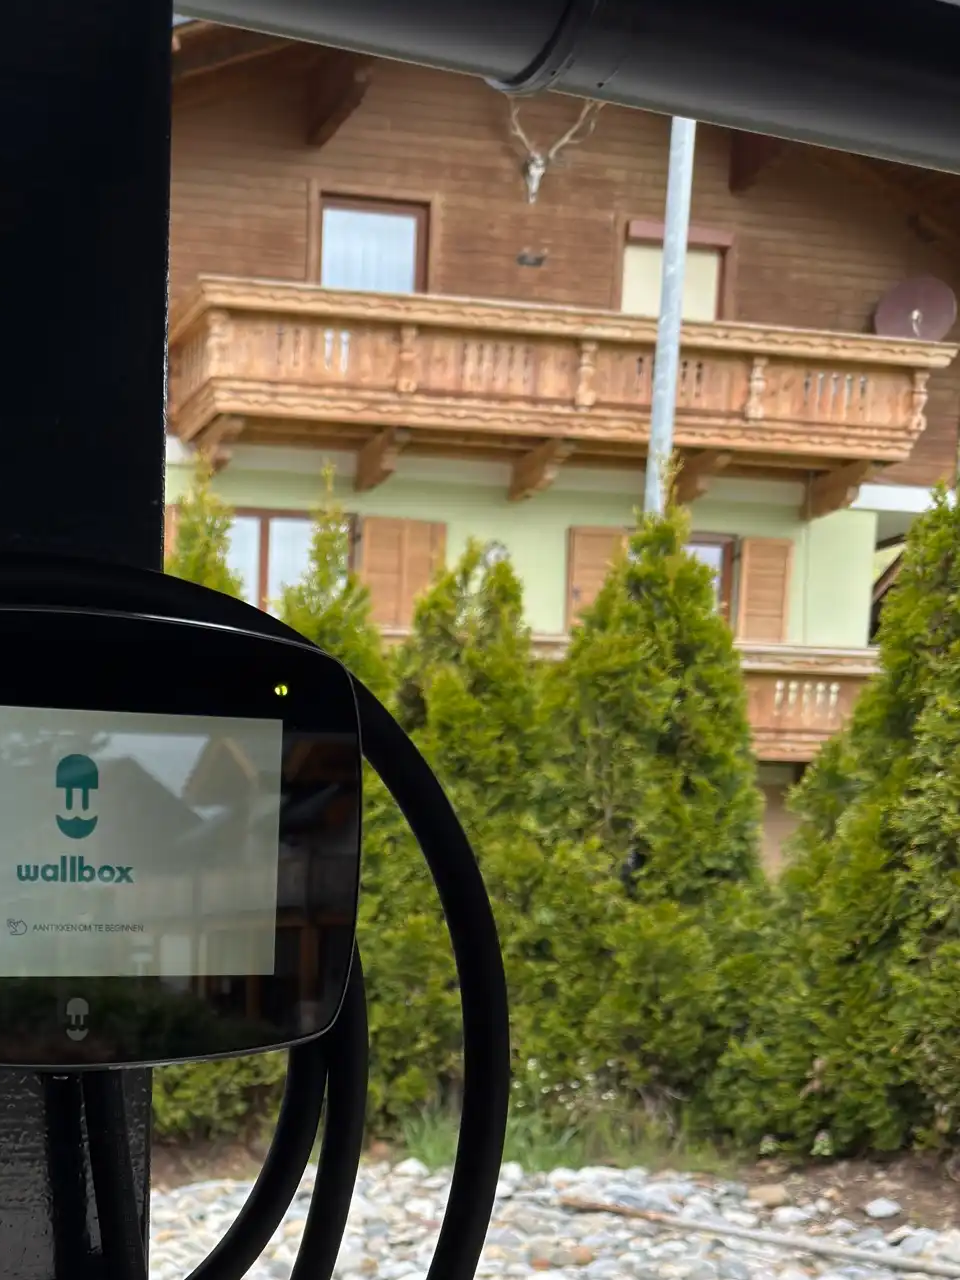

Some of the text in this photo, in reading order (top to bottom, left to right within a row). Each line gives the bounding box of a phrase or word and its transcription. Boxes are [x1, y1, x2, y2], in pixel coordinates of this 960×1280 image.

[17, 855, 133, 883] wallbox
[78, 923, 92, 933] OM
[93, 923, 104, 933] TE
